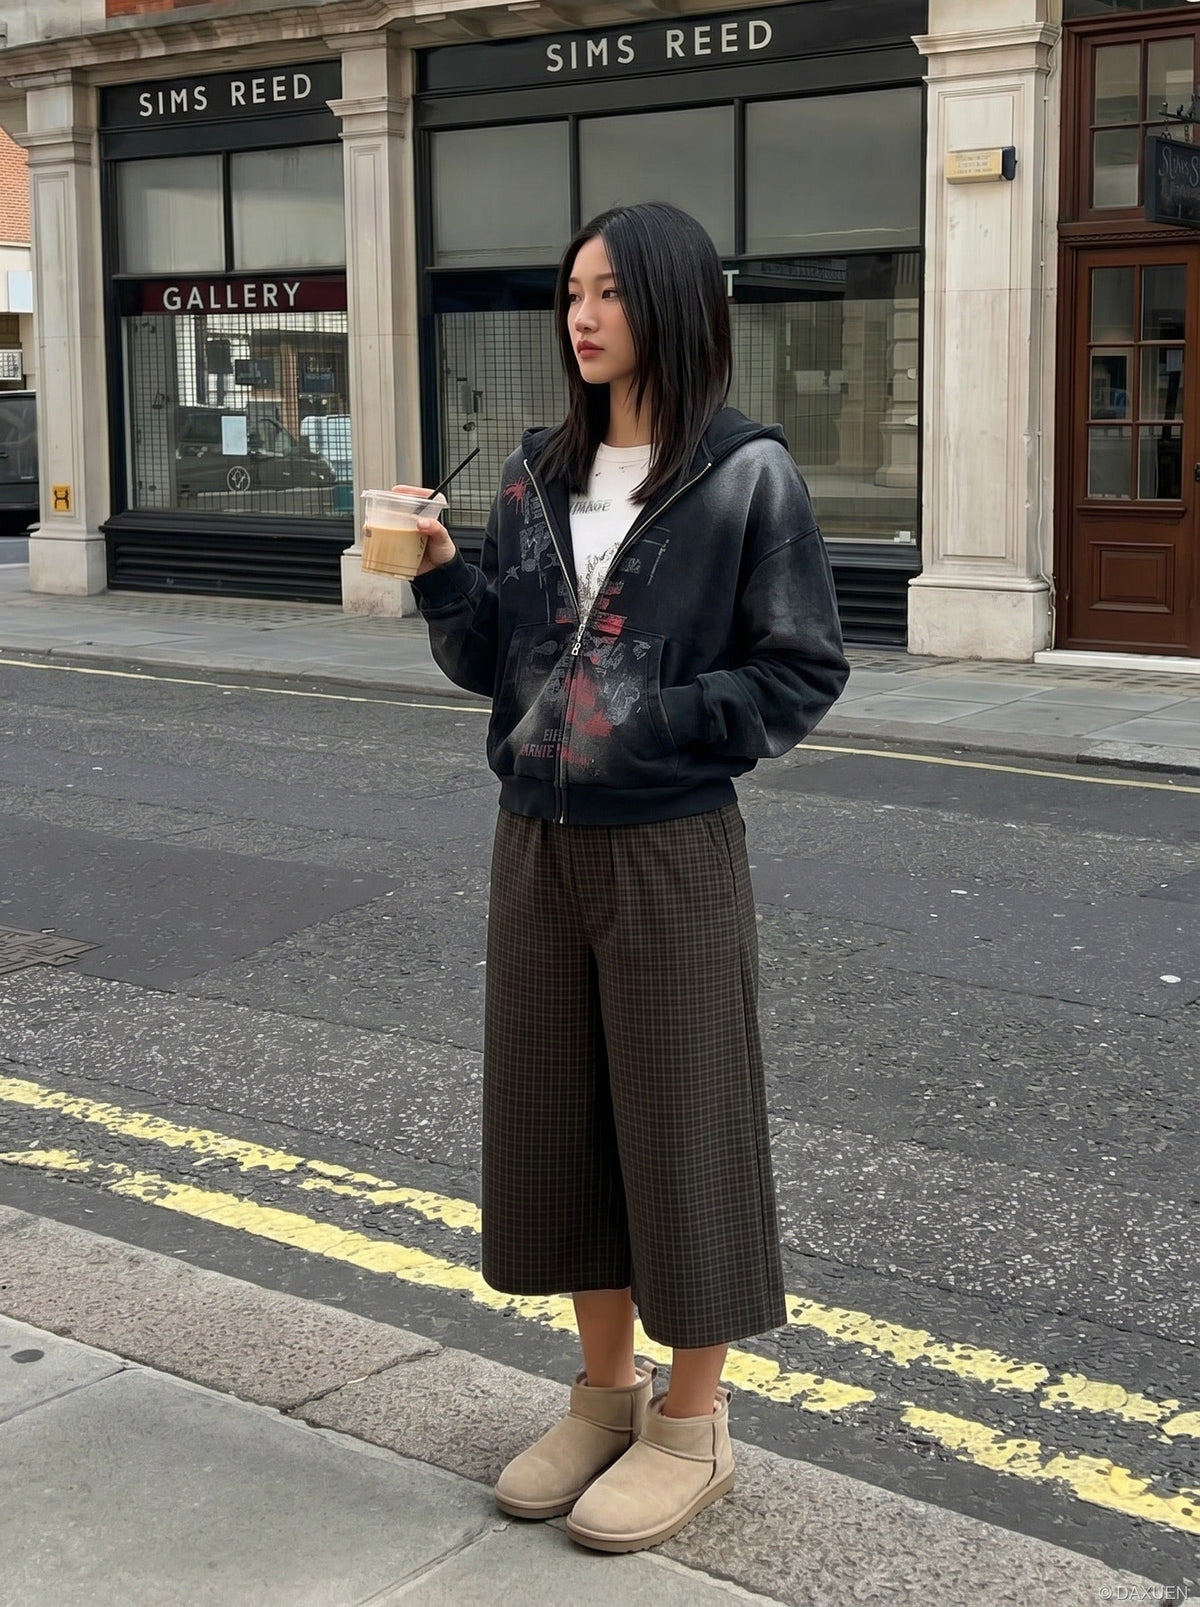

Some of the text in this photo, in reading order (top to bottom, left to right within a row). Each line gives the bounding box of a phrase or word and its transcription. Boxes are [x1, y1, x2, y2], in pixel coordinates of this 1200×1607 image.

[546, 20, 773, 72] SIMS REED
[139, 73, 312, 117] SIMS REED
[163, 282, 301, 311] GALLERY
